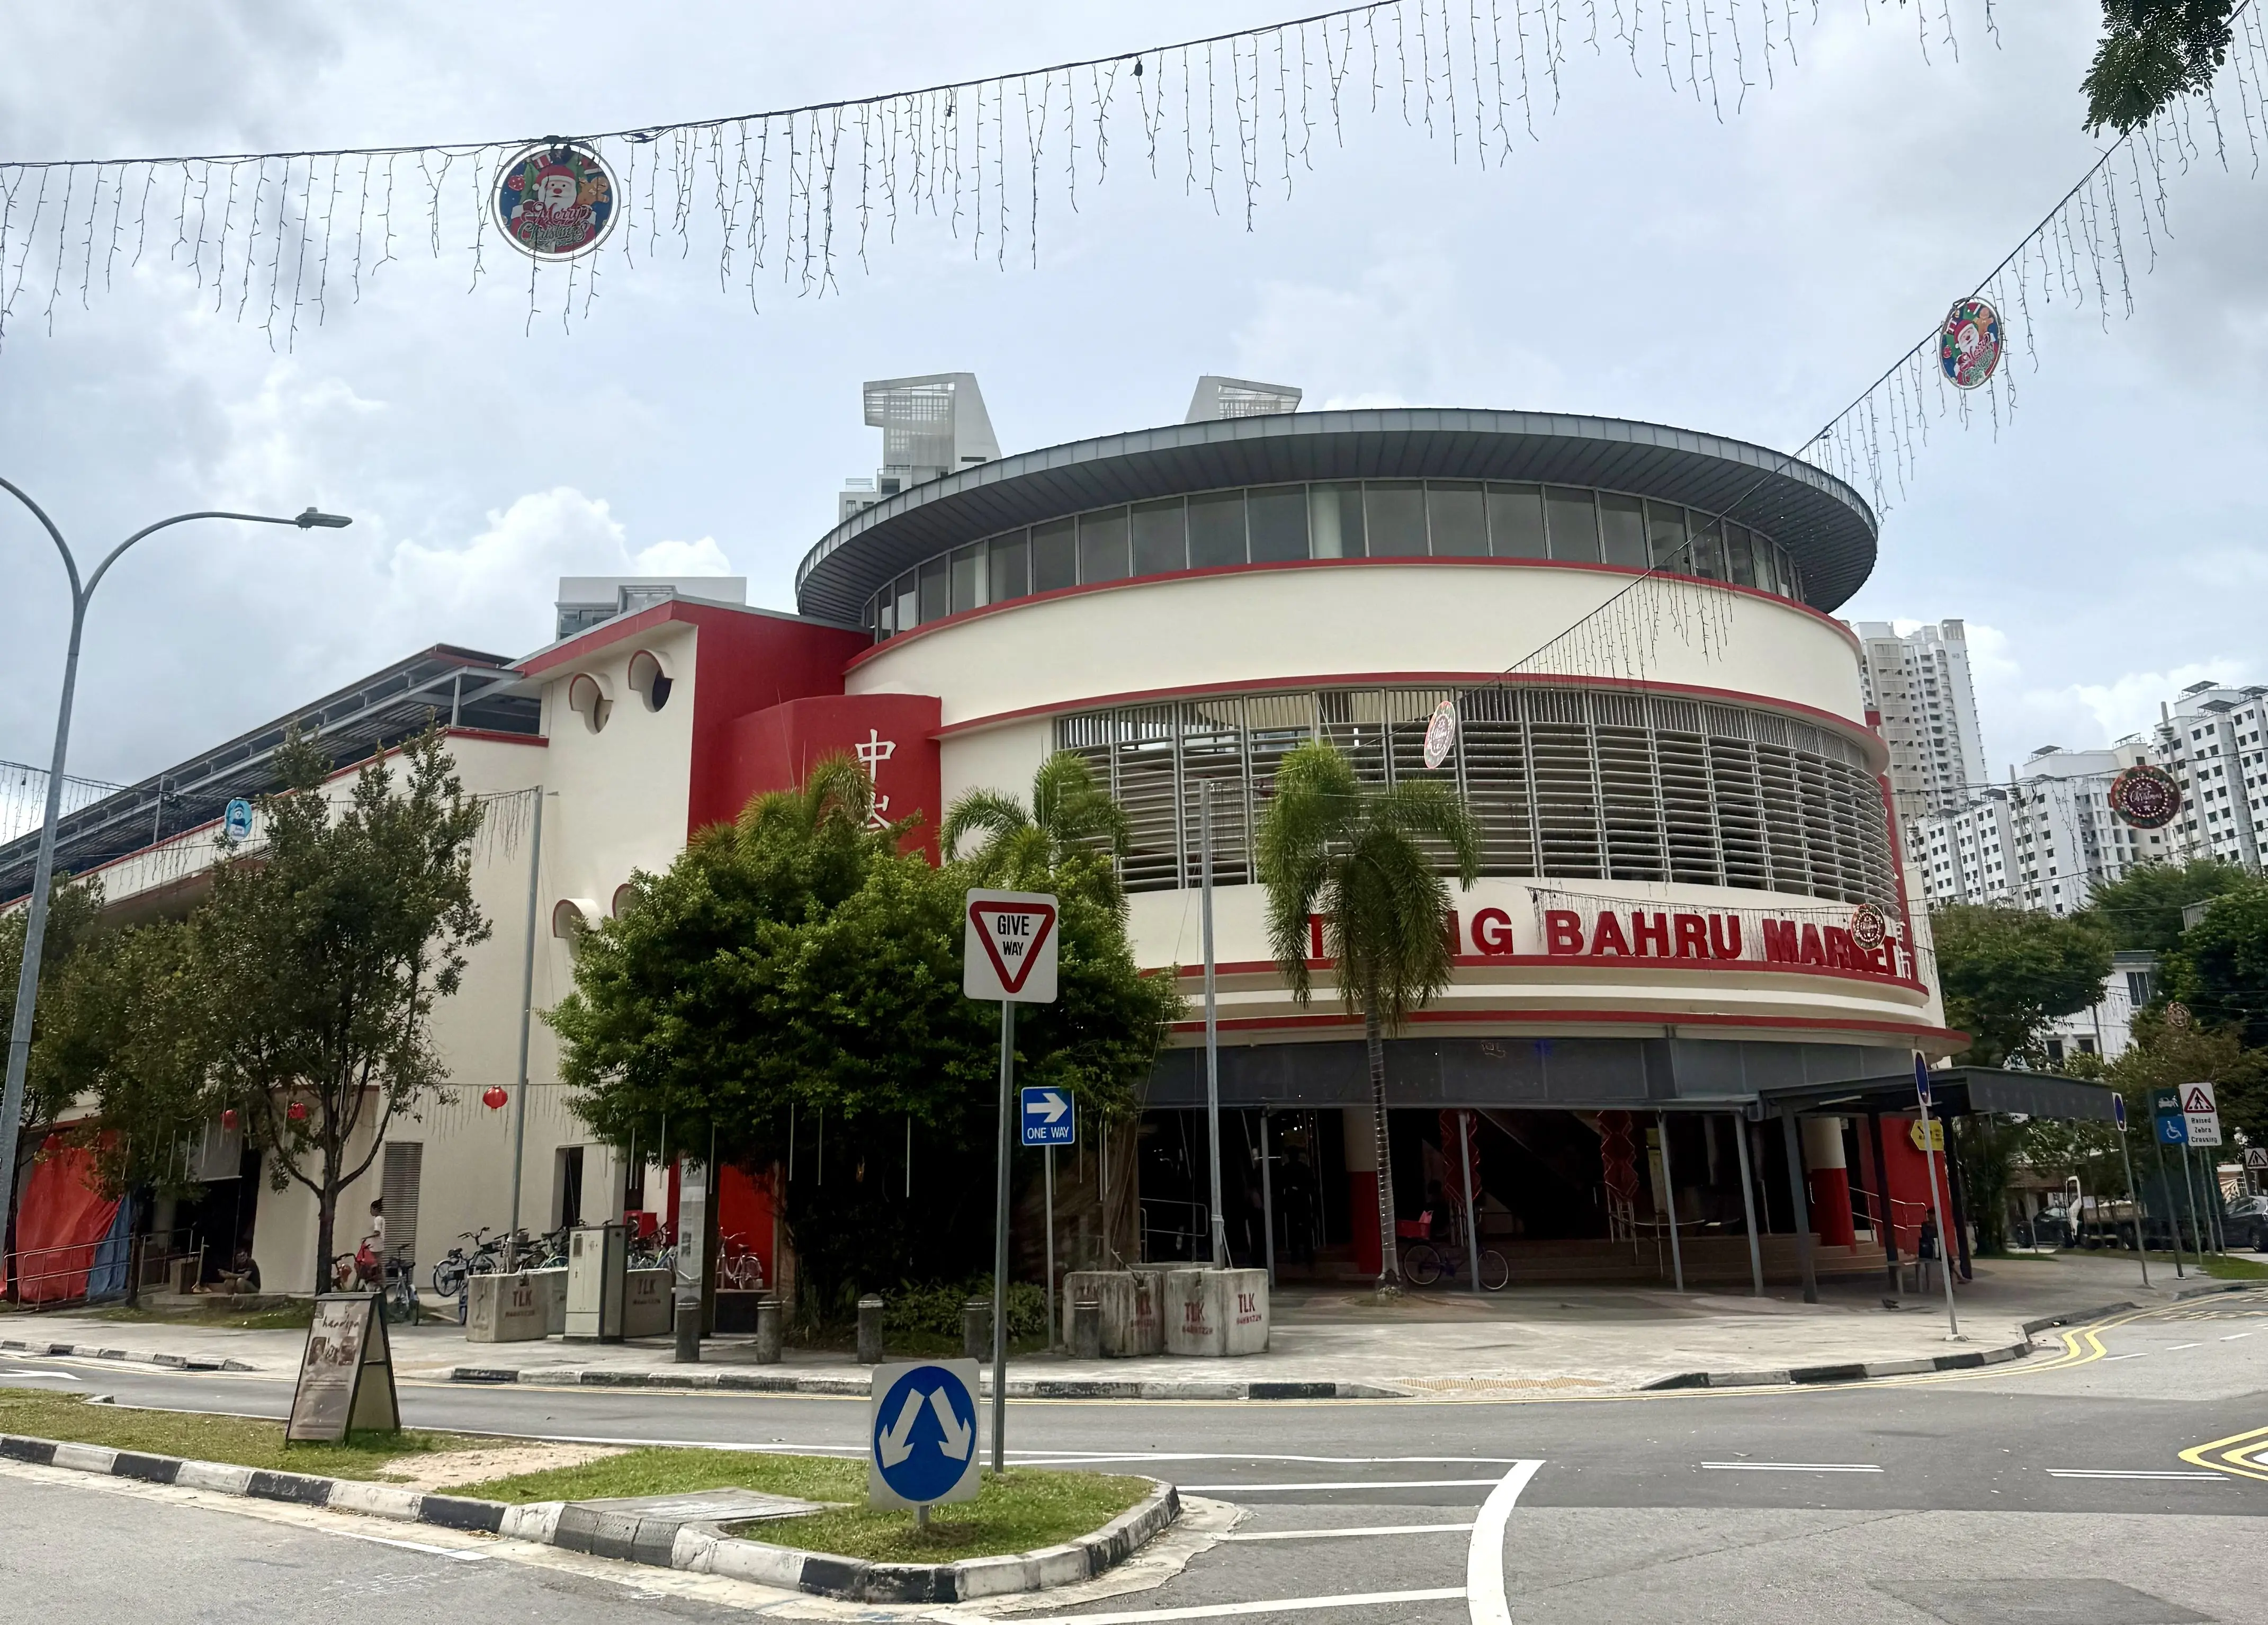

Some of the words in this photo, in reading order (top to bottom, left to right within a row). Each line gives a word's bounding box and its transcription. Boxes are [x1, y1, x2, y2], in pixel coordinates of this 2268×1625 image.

[521, 201, 591, 226] Merry
[517, 220, 590, 246] Christmas
[998, 915, 1029, 936] GIVE
[1545, 909, 1742, 960] BAHRU
[1002, 941, 1024, 956] WAY
[1027, 1127, 1046, 1139] ONE
[1051, 1126, 1069, 1138] WAY
[637, 1279, 656, 1294] TLK
[513, 1289, 532, 1307] TLK
[1238, 1292, 1256, 1314] TLK
